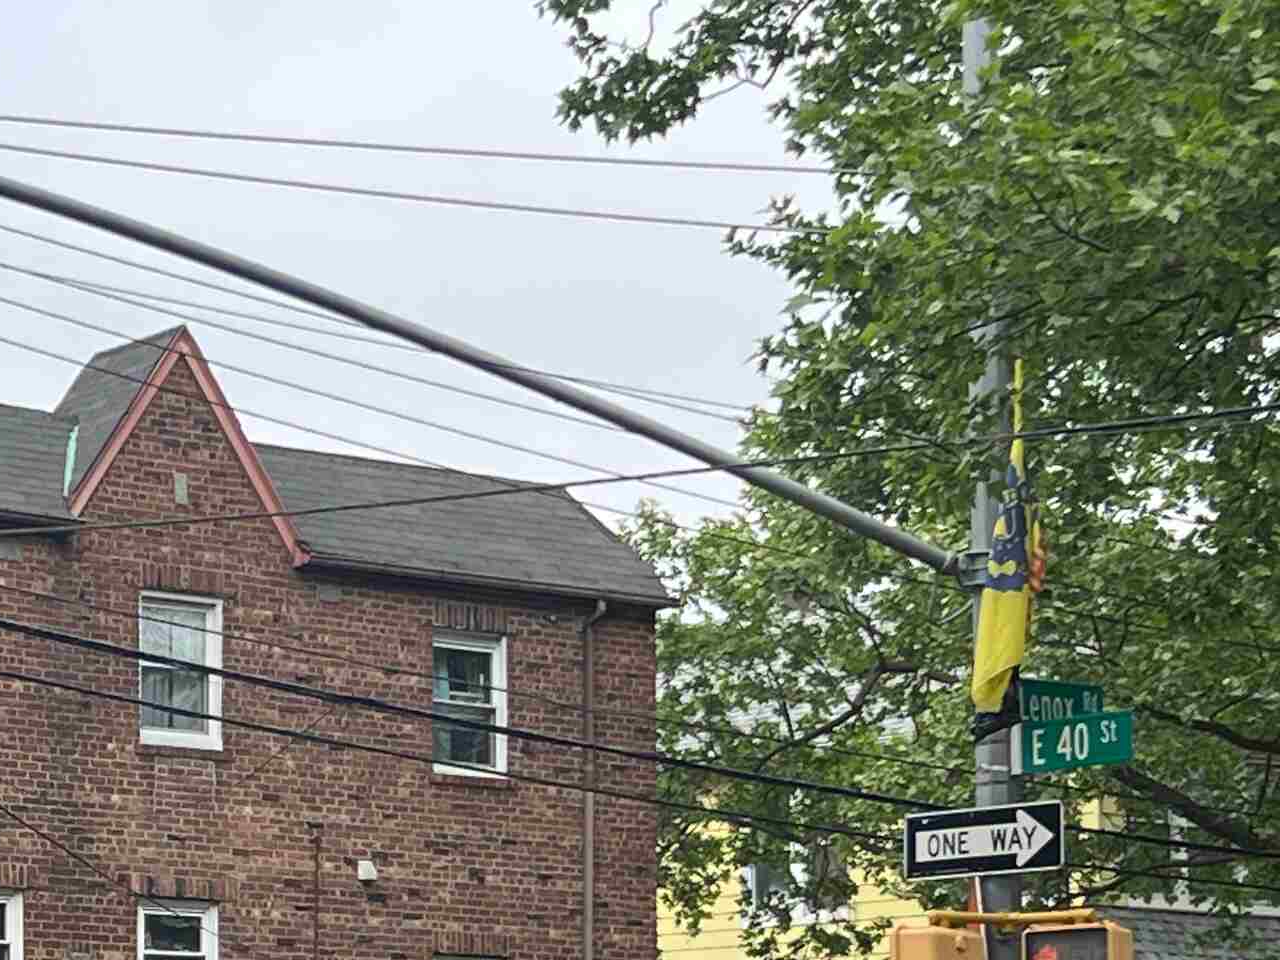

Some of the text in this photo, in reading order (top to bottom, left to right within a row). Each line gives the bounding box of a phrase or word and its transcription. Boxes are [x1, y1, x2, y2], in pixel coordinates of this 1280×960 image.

[1018, 687, 1098, 721] Lenox Rd
[1032, 720, 1118, 766] E 40 St
[928, 825, 1037, 857] ONE WAY
